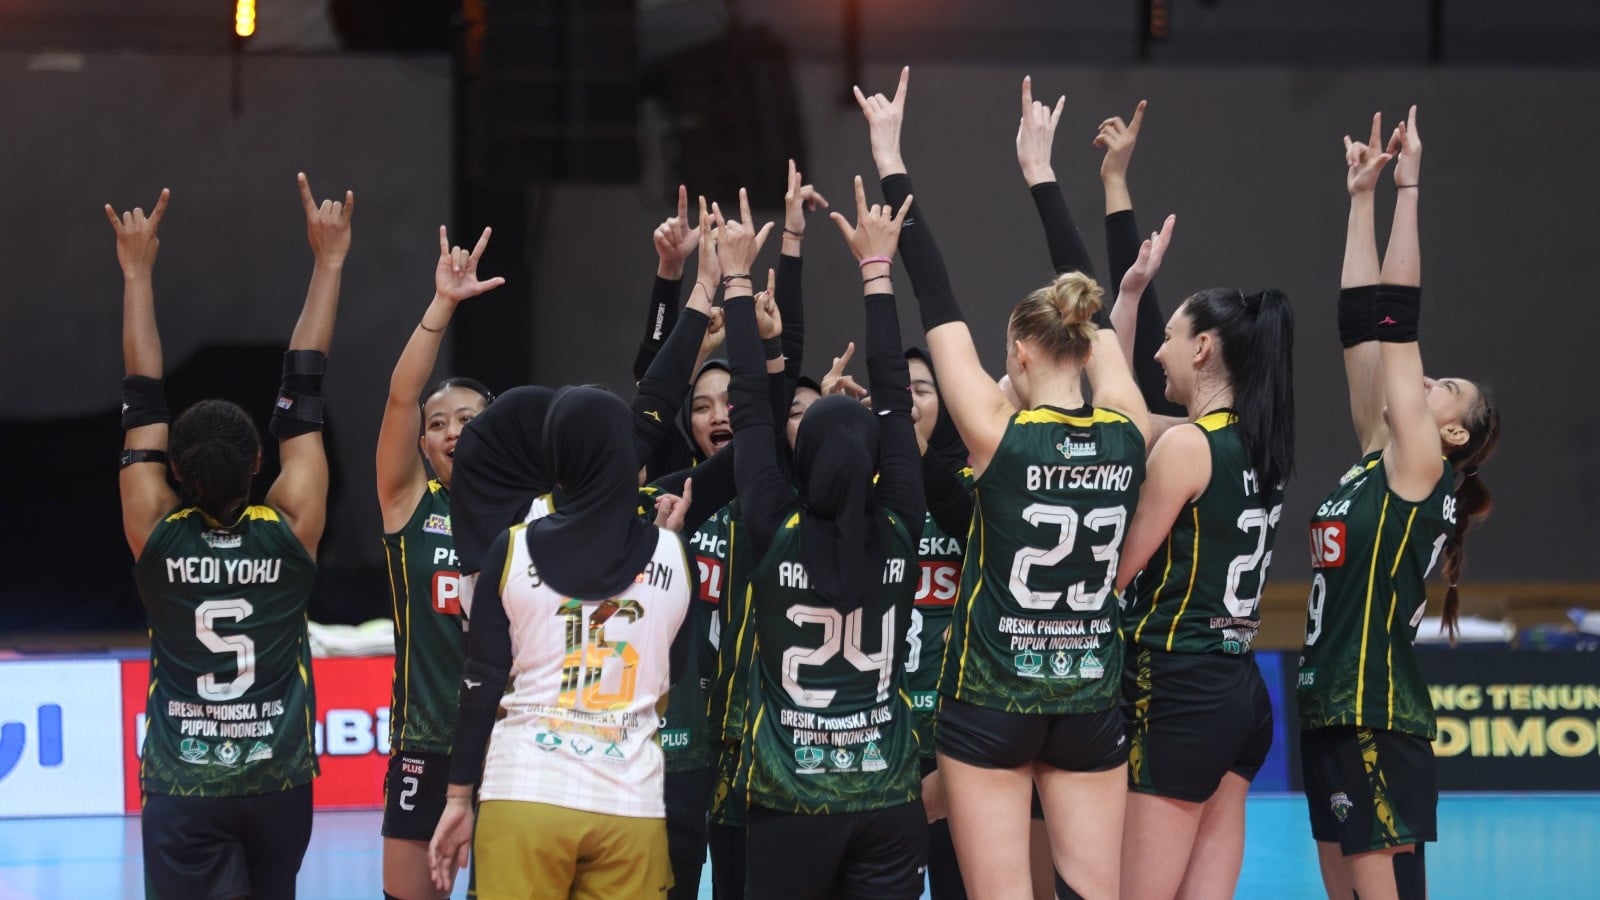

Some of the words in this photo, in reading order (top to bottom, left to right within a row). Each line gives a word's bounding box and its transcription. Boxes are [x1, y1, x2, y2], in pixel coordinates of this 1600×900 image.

[1027, 465, 1134, 492] BYTSENKO
[1009, 502, 1127, 611] 23
[224, 559, 281, 584] YOKU
[1305, 573, 1326, 646] 9
[998, 617, 1035, 635] GRESIK
[1037, 619, 1086, 635] PHONSKA
[1090, 617, 1111, 634] PLUS
[195, 598, 255, 701] 5
[555, 598, 644, 711] 16
[782, 603, 896, 708] 24
[1010, 634, 1046, 651] PUPUK
[1048, 634, 1100, 650] INDONESIA
[168, 700, 205, 718] GRESIK
[206, 703, 257, 721] PHONSKA
[262, 699, 284, 718] PLUS
[781, 709, 816, 730] GRESIK
[817, 711, 867, 731] PHONSKA
[871, 705, 892, 726] PLUS
[181, 720, 218, 737] PUPUK
[220, 720, 275, 739] INDONESIA
[661, 733, 688, 747] PLUS
[793, 728, 829, 746] PUPUK
[831, 726, 883, 747] INDONESIA
[1431, 716, 1600, 758] DIMO
[402, 763, 424, 775] PLUS
[400, 776, 418, 811] 2
